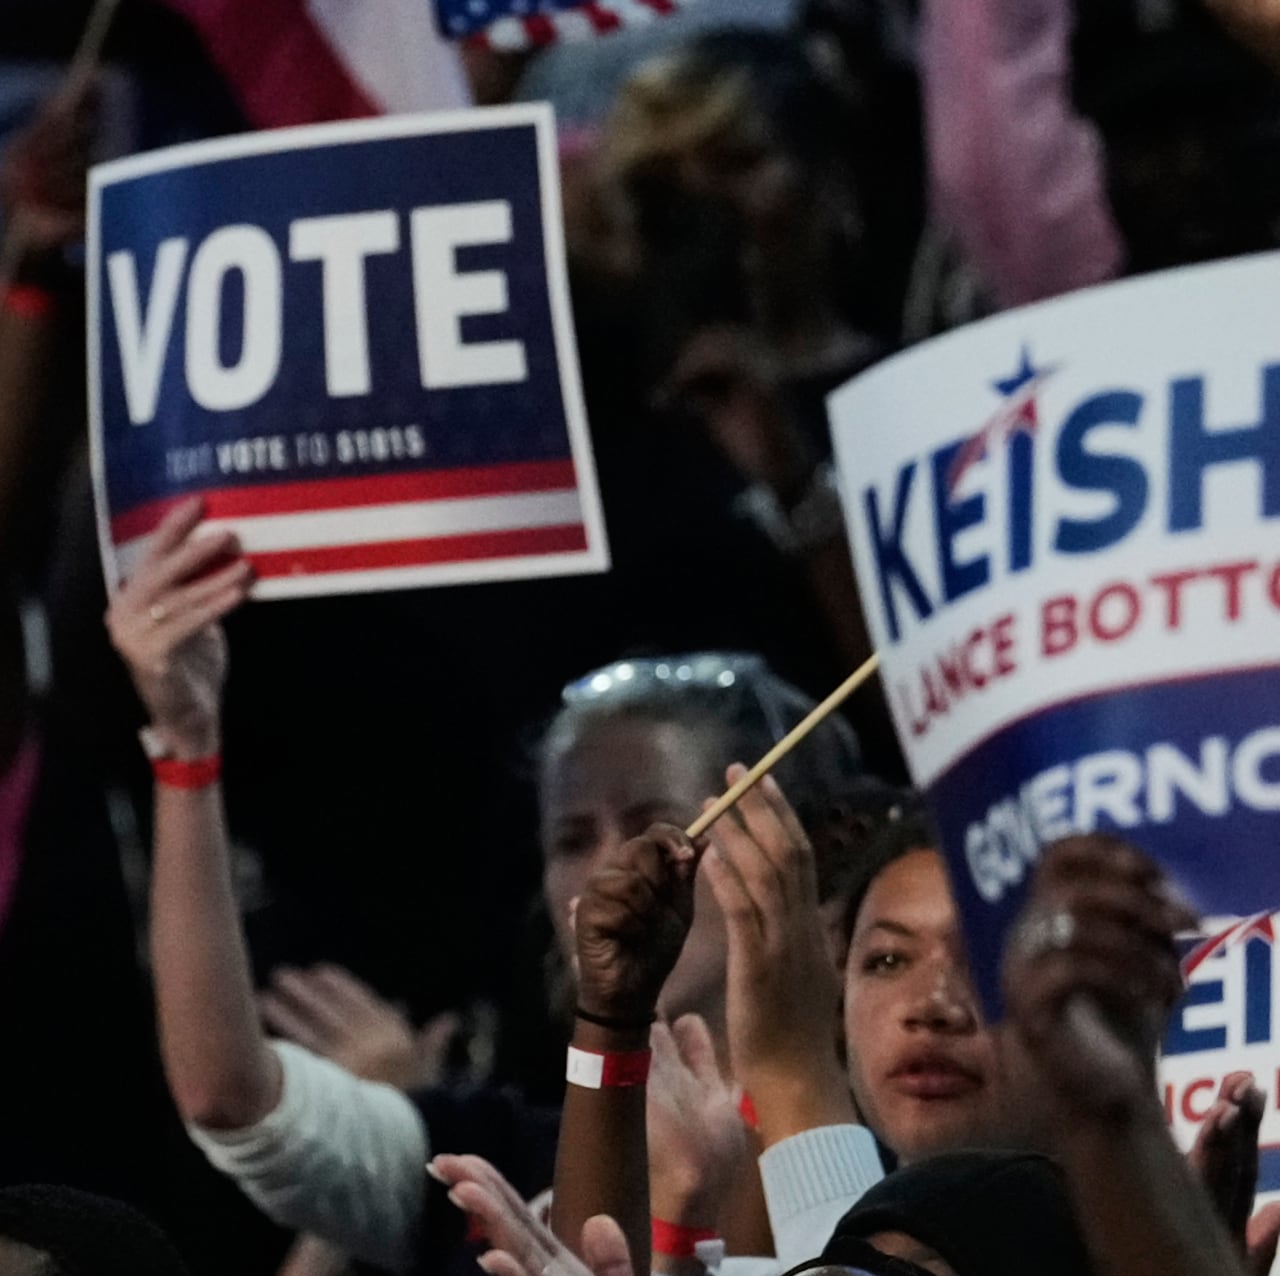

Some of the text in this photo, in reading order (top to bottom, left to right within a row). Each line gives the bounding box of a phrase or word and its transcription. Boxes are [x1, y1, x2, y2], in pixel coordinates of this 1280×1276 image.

[107, 199, 529, 427] VOTE
[216, 434, 286, 475] VOTE
[1040, 560, 1280, 658] BOTT
